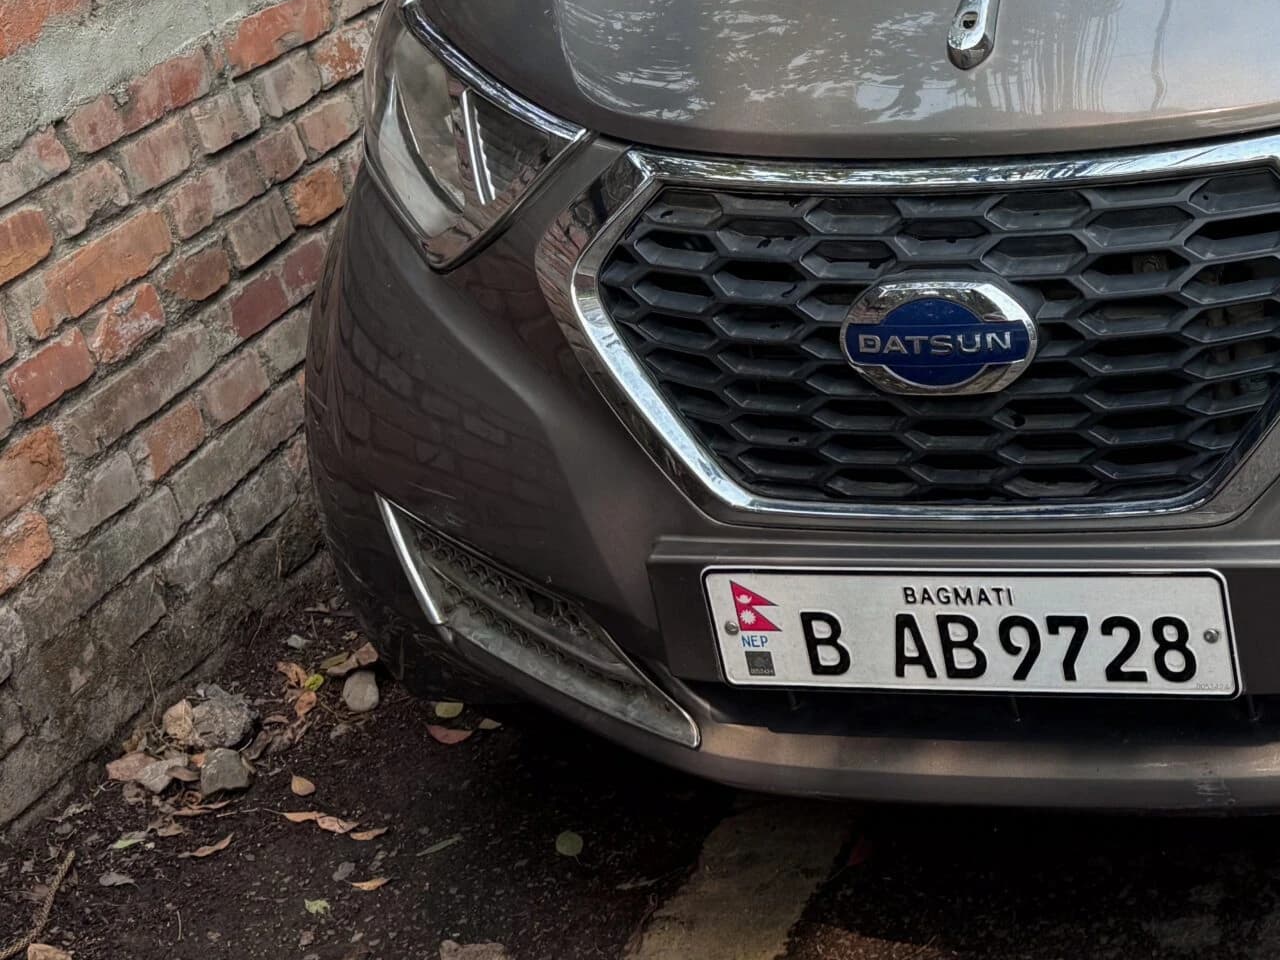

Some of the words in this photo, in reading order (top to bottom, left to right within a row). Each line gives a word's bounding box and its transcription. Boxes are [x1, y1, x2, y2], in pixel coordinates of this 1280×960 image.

[858, 331, 1012, 355] DATSUN
[902, 586, 1014, 607] BAGMATI
[741, 634, 769, 648] NEP
[800, 611, 852, 676] B
